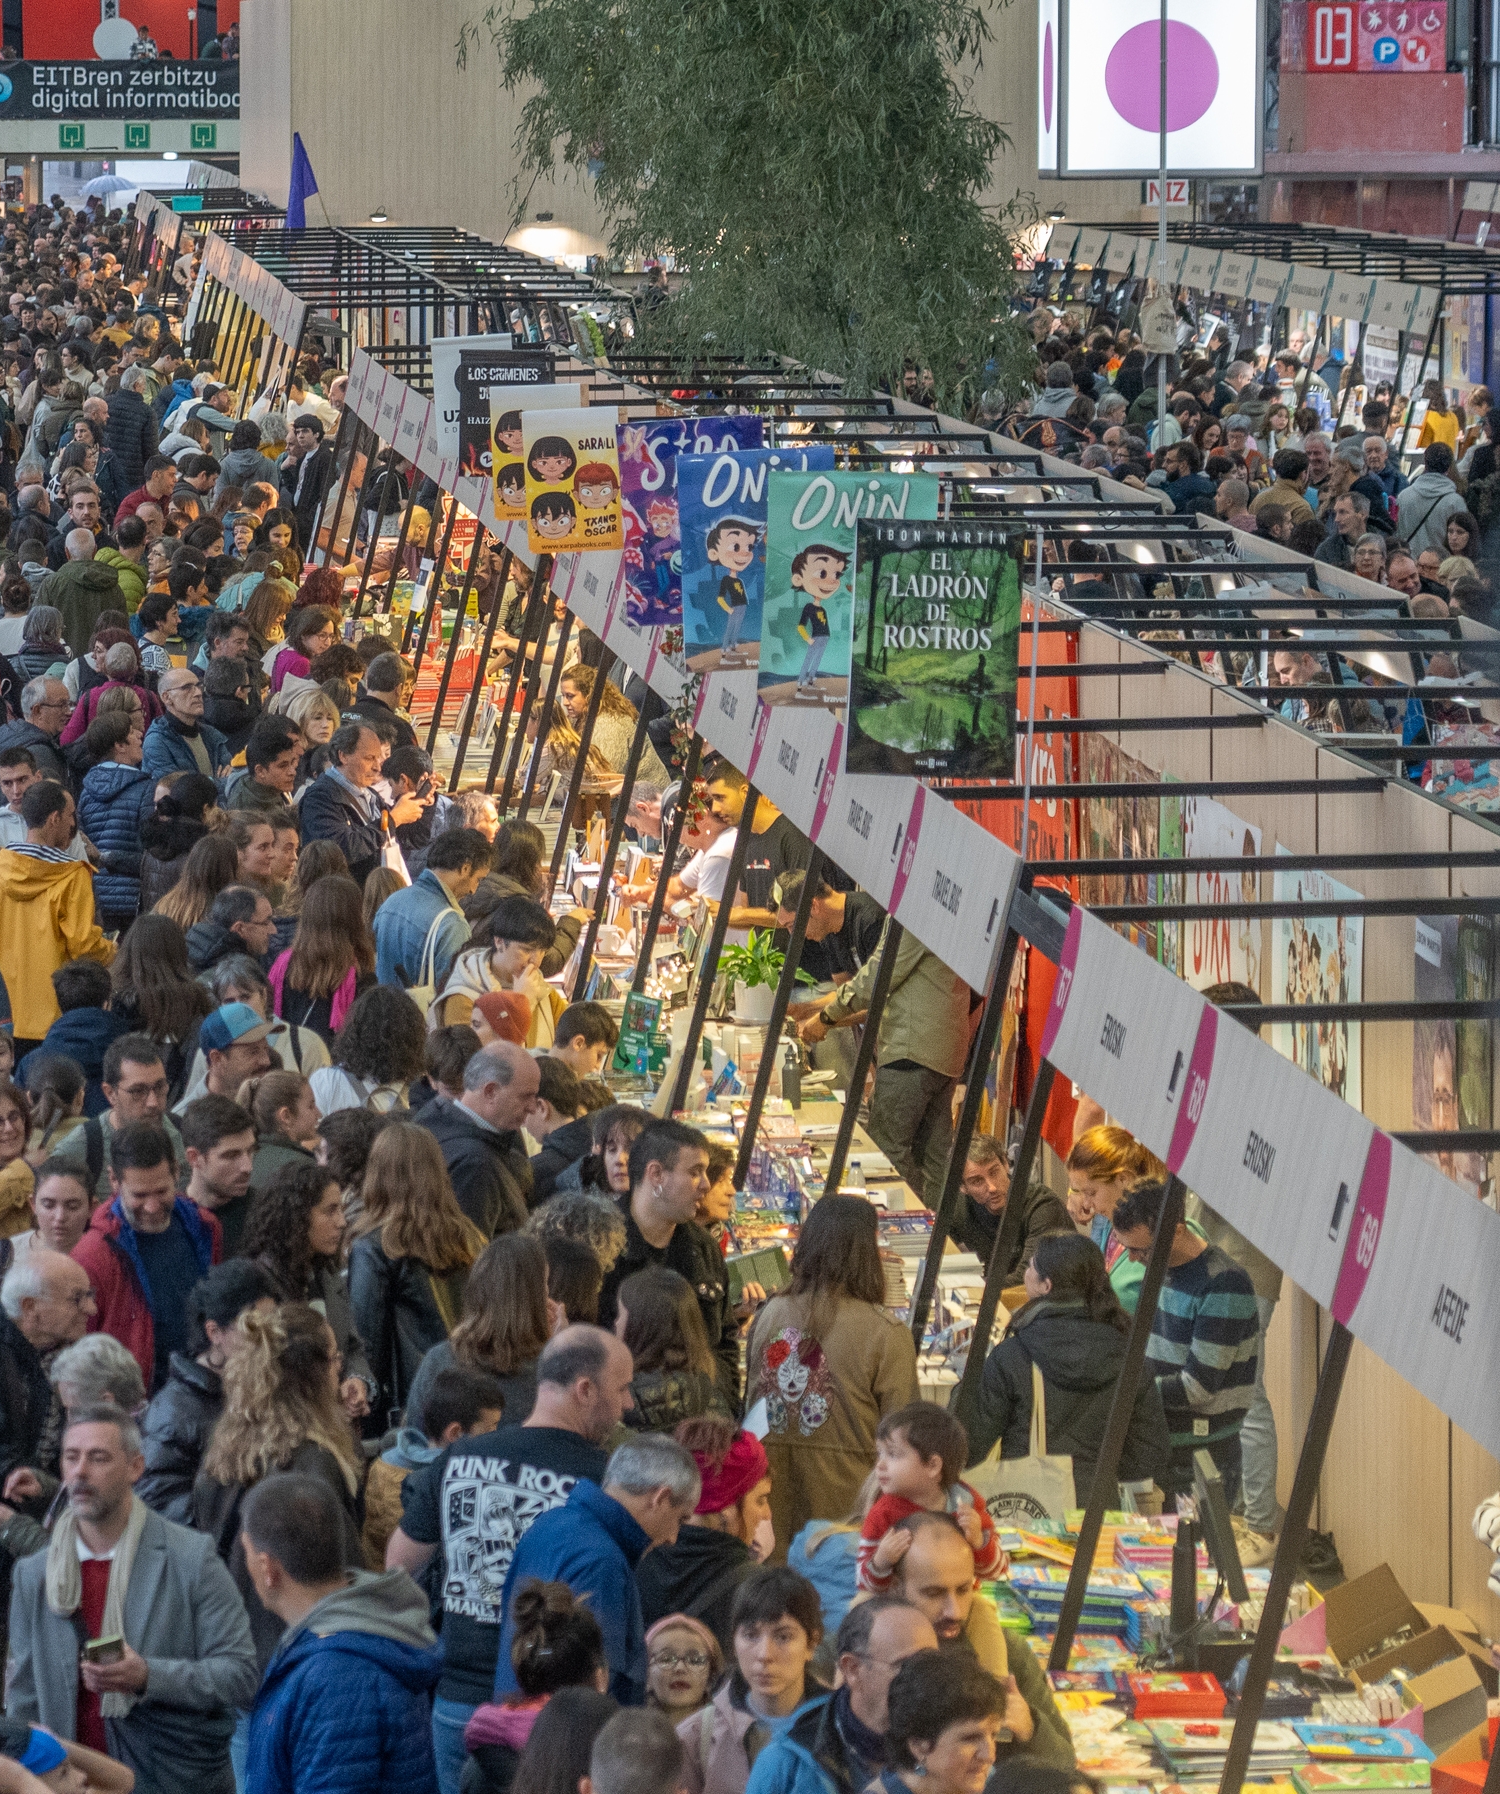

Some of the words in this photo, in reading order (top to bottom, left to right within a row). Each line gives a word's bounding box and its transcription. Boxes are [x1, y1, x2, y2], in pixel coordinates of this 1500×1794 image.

[1315, 7, 1353, 65] 03
[33, 66, 123, 86] EITBren
[129, 66, 217, 86] zerbitzu
[32, 88, 100, 113] digital
[468, 367, 487, 380] LOS
[584, 514, 617, 527] TXANO
[584, 524, 617, 537] OSCAR
[541, 540, 612, 551] www.xarpabooks.com
[877, 528, 922, 542] IBON
[936, 528, 1008, 545] MARTÍN
[931, 552, 952, 572] EL
[891, 569, 990, 601] LADRÓN
[927, 603, 951, 622] DE
[883, 625, 992, 651] ROSTROS
[1243, 1130, 1277, 1185] EROSKI
[1431, 1283, 1470, 1345] AFEDE
[446, 1455, 511, 1483] PUNK
[517, 1463, 579, 1499] ROC
